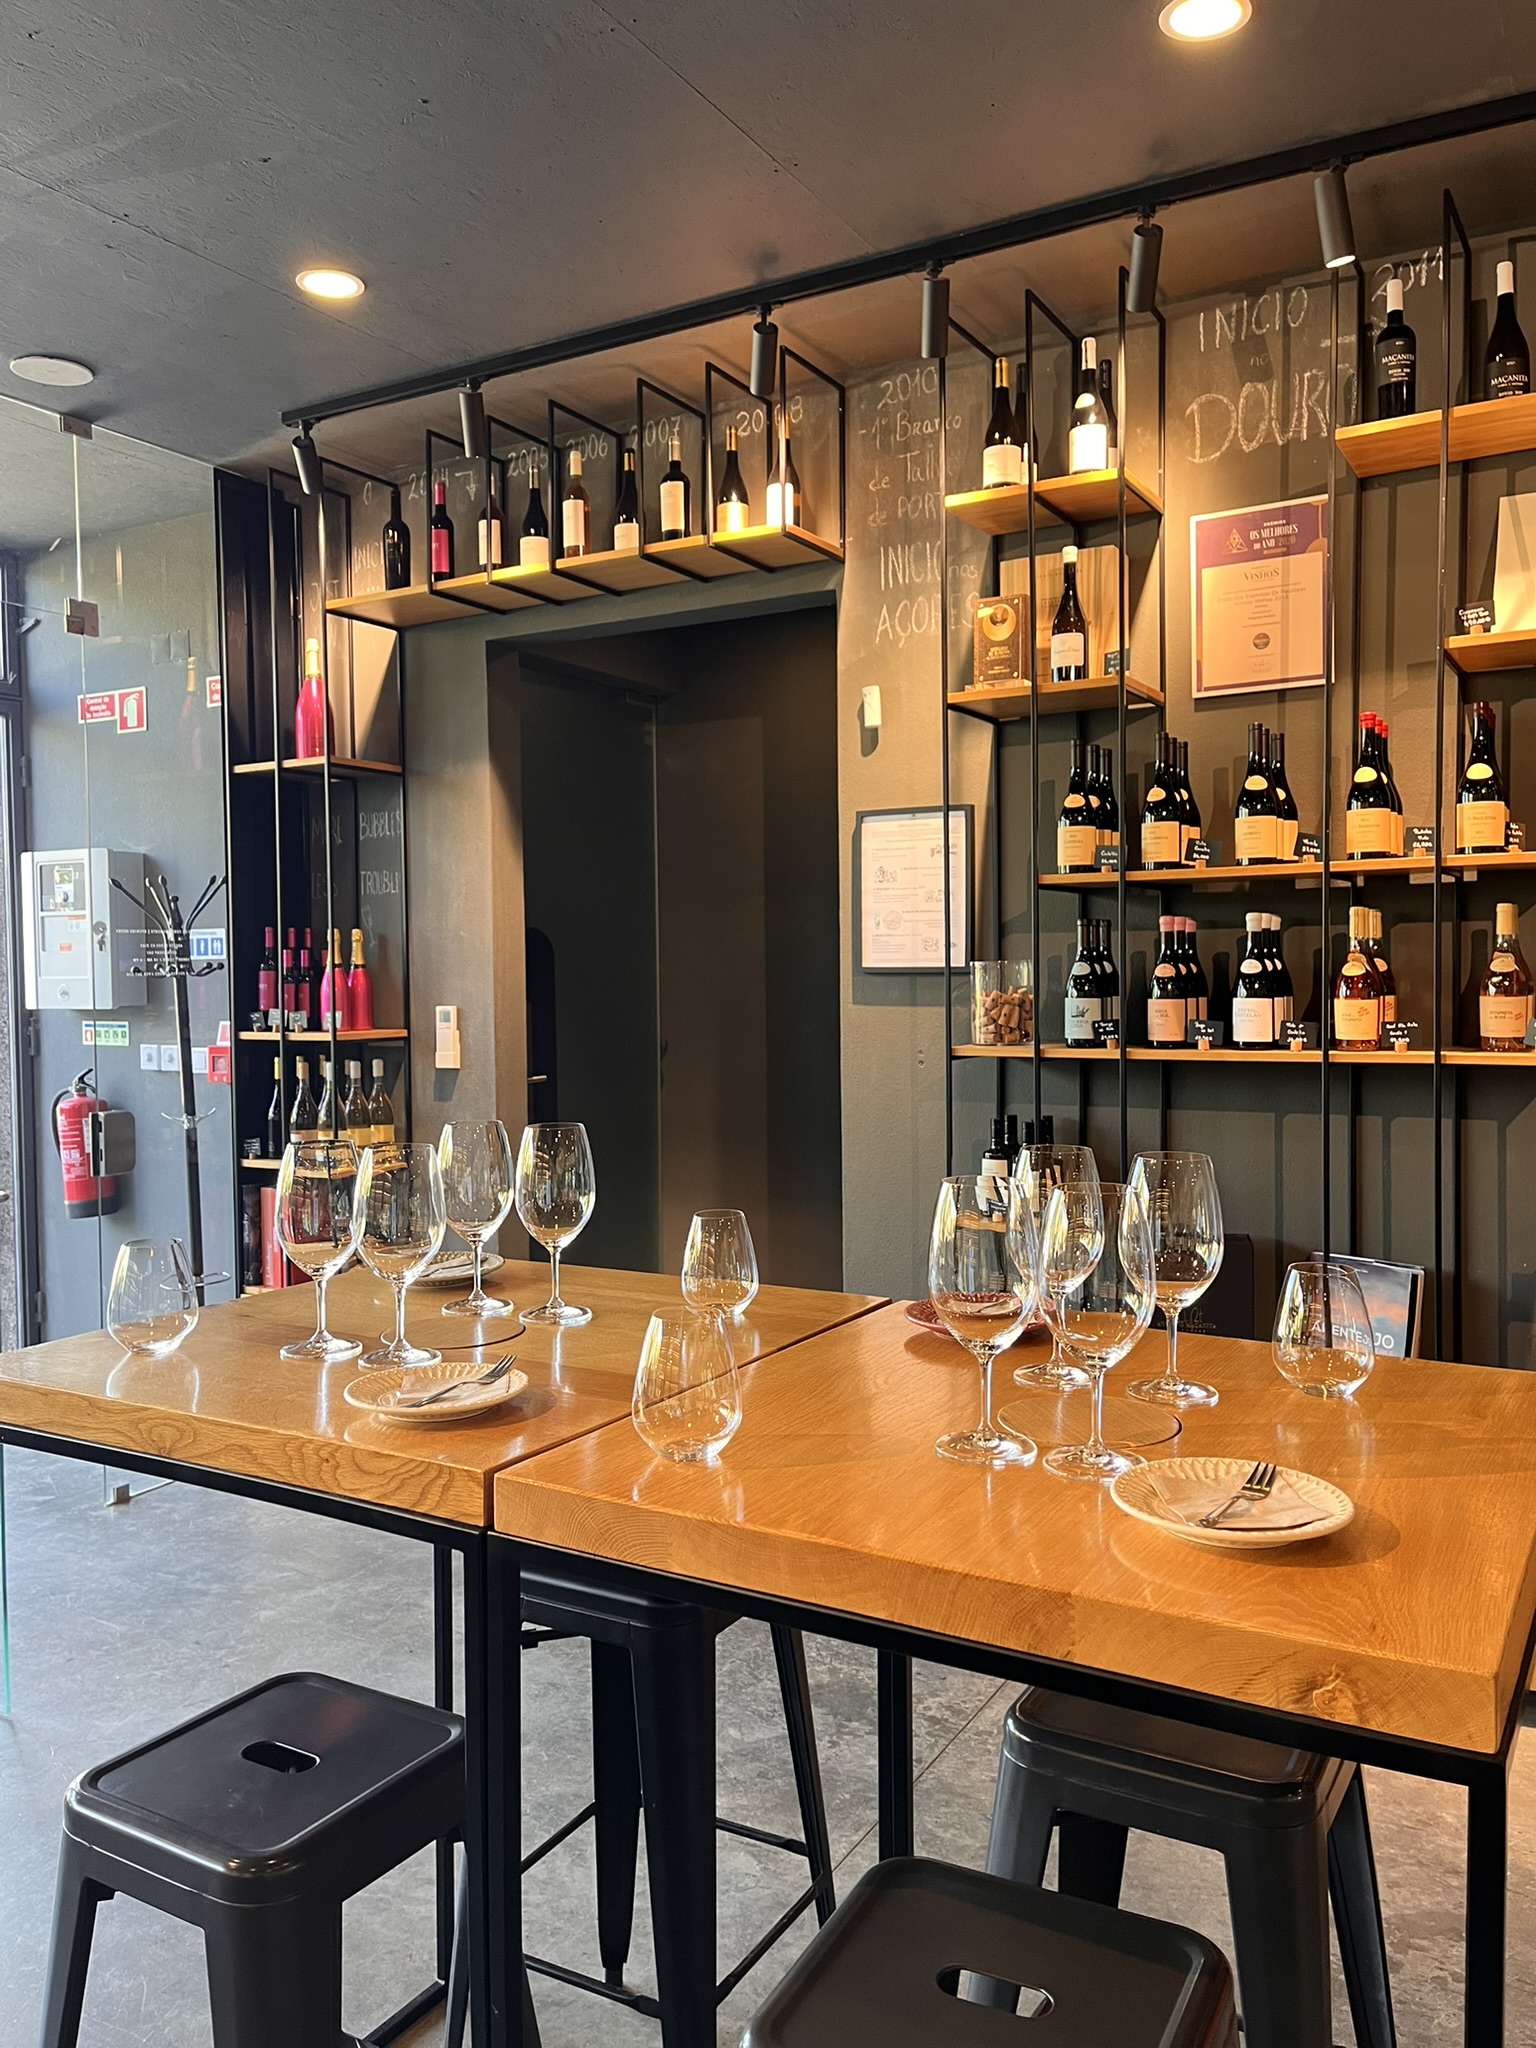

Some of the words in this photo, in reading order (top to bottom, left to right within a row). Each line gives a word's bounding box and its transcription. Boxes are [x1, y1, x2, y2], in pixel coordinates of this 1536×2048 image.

[1381, 353, 1415, 364] MAÇANITA
[1490, 374, 1528, 386] MAÇANITA
[877, 366, 938, 409] 2010
[1260, 523, 1299, 538] MELHORES
